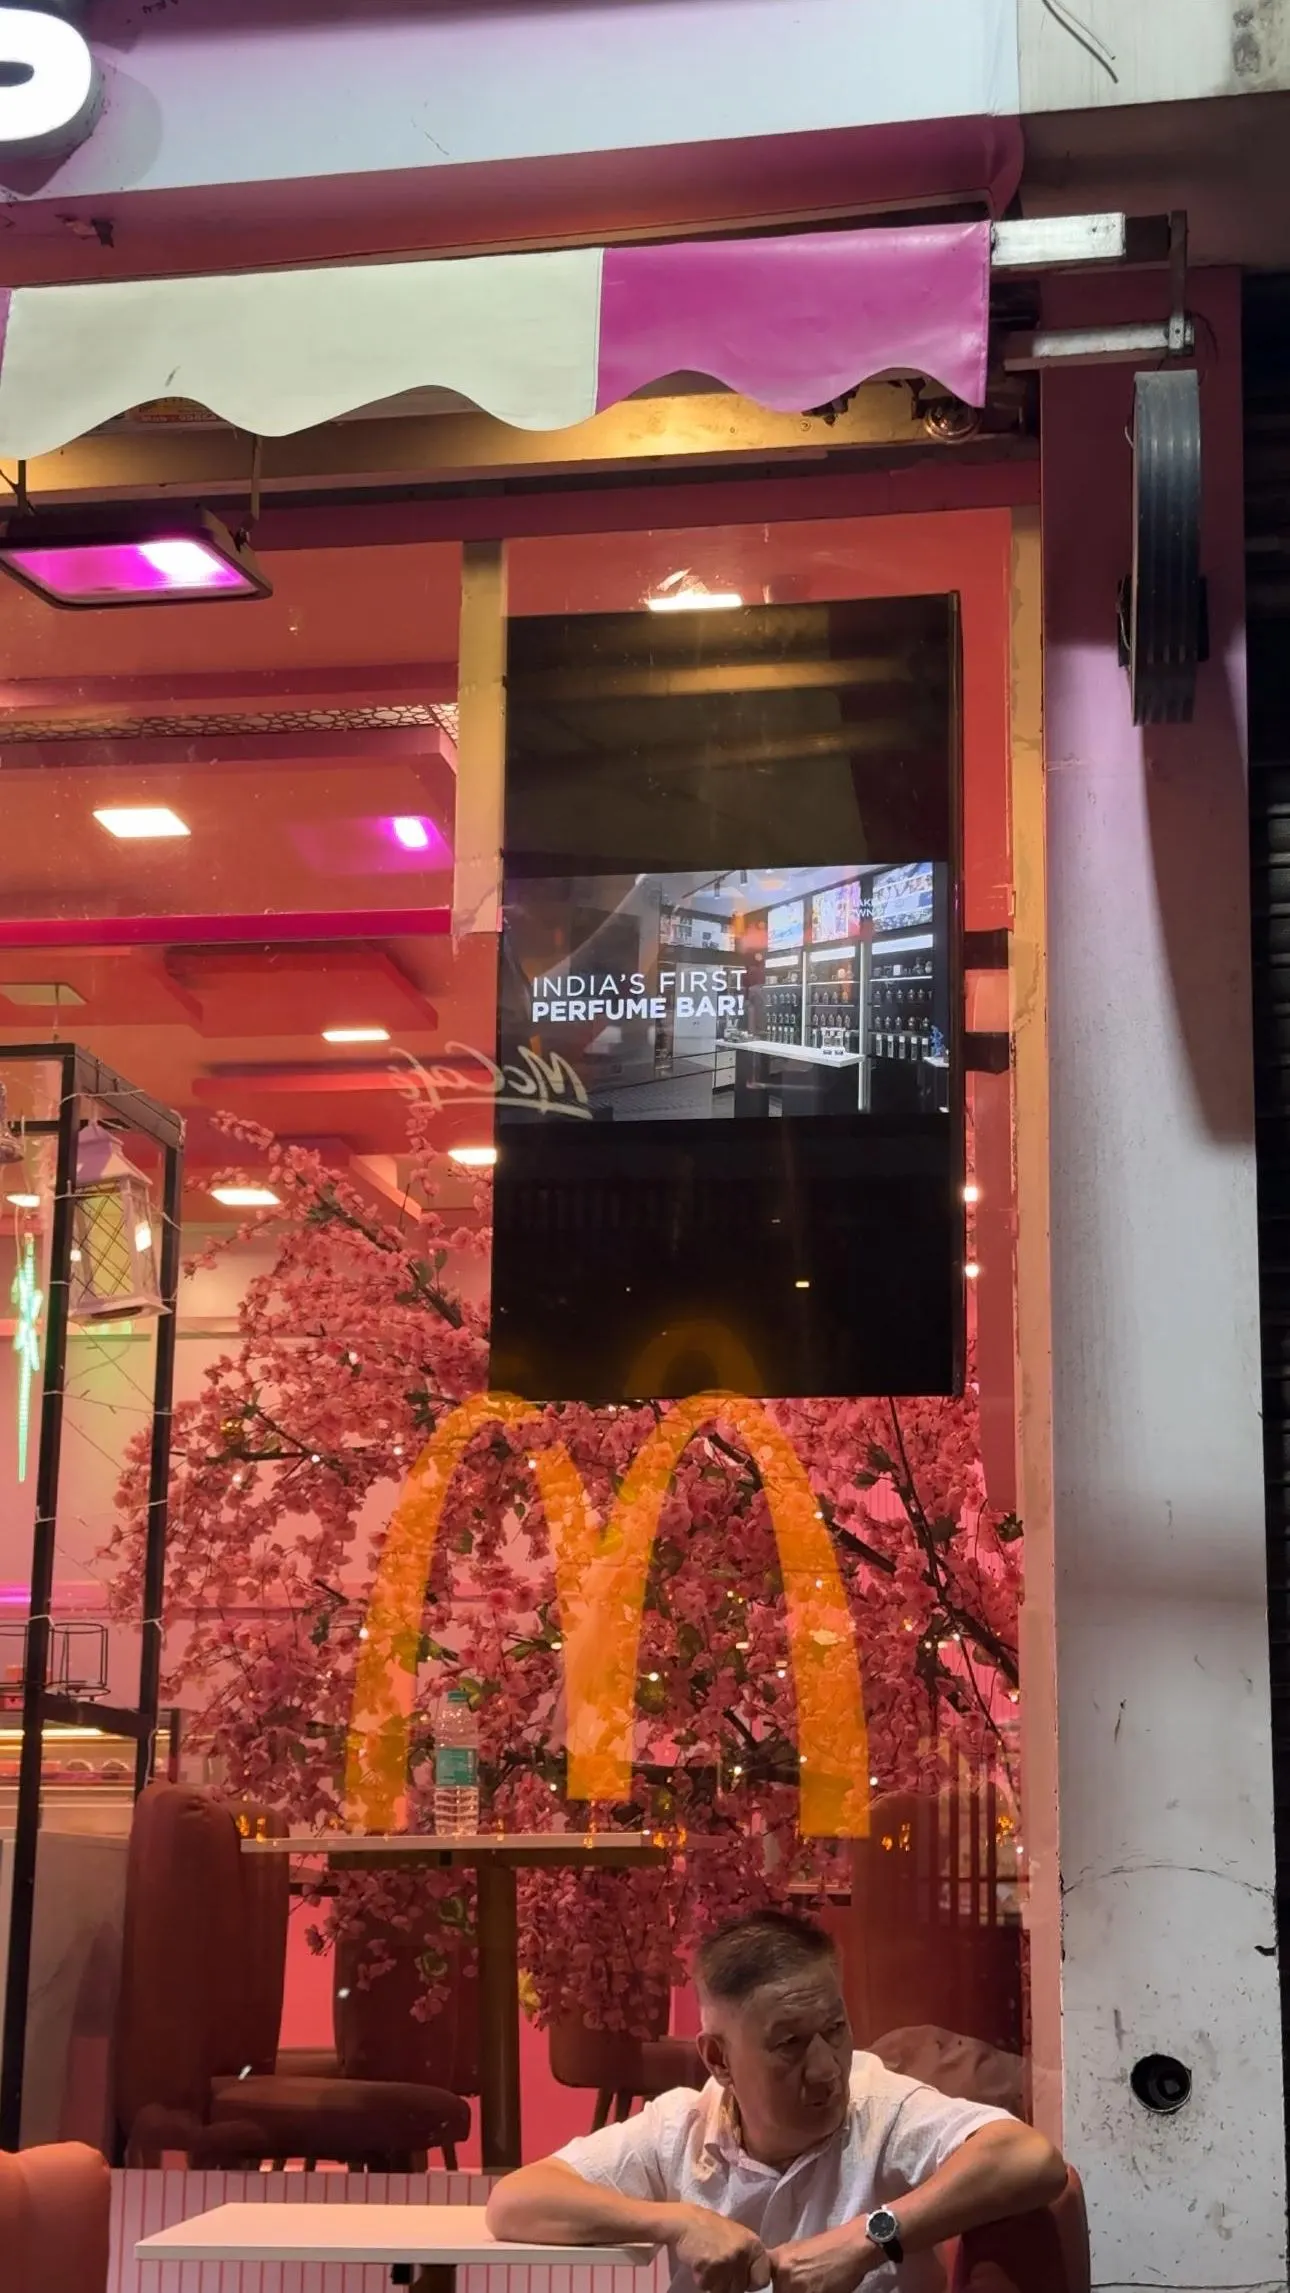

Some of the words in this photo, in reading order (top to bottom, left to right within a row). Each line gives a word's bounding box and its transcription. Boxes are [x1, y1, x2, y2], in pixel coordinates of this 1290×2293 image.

[533, 973, 645, 997] INDIA'S
[659, 969, 747, 993] FIRST
[532, 997, 666, 1022] PERFUME
[677, 994, 745, 1018] BAR!
